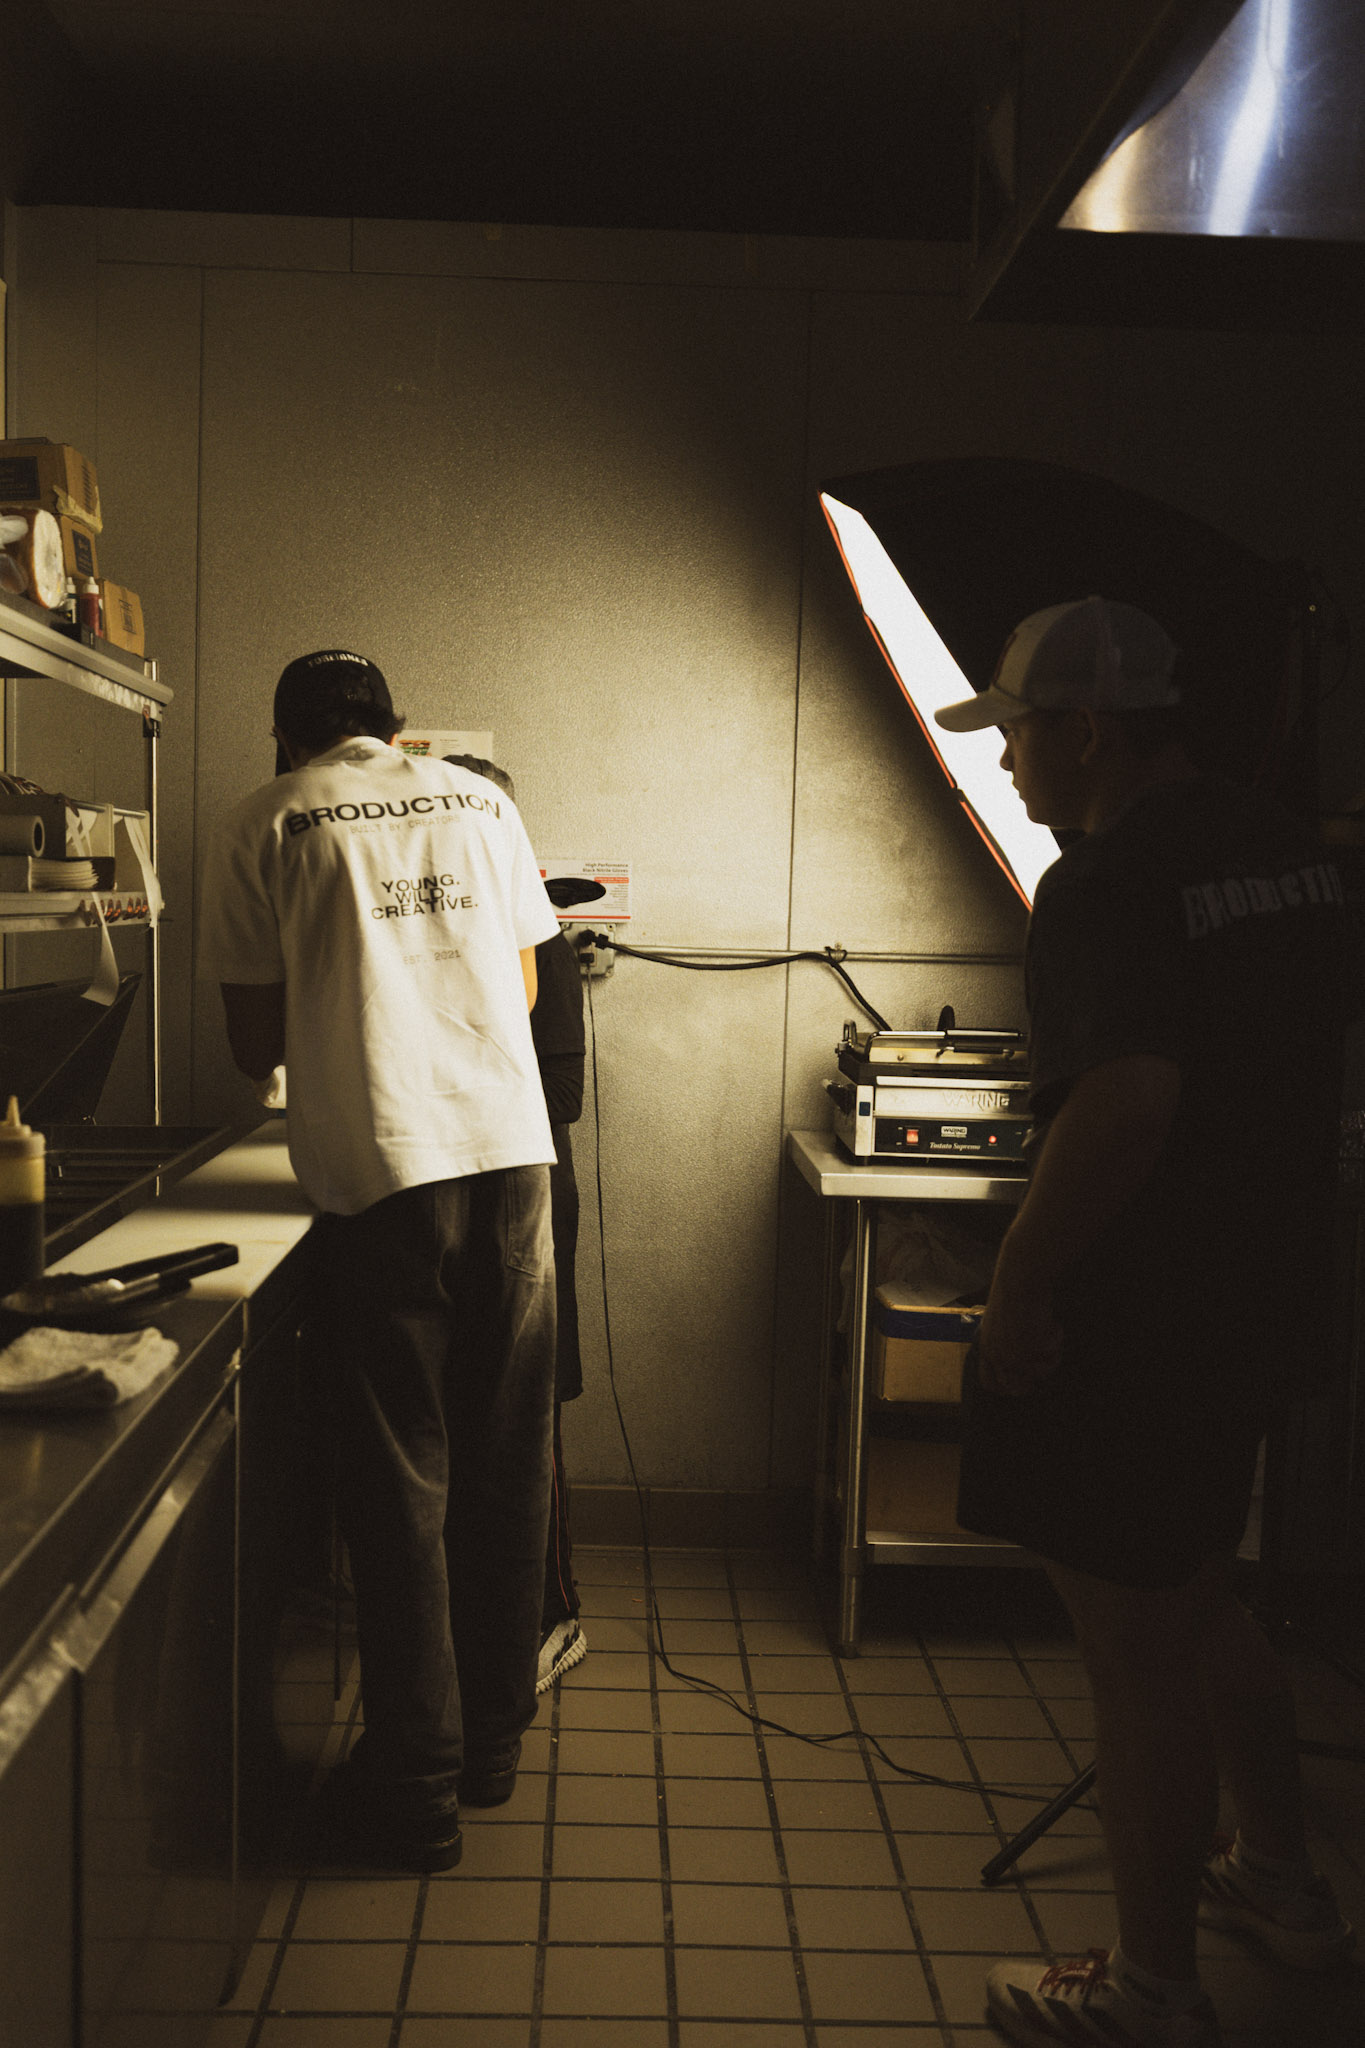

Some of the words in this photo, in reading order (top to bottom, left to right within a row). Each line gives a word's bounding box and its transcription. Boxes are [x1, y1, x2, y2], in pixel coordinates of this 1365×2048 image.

[285, 793, 500, 837] BRODUCTION
[349, 822, 382, 834] BUILT
[388, 821, 401, 833] BY
[407, 814, 461, 830] CREATORS
[381, 873, 460, 893] YOUNG.
[395, 887, 451, 904] WILD.
[371, 896, 479, 920] CREATIVE.
[434, 949, 461, 961] 2021
[942, 1090, 1010, 1112] WARING
[943, 1127, 966, 1136] WARING
[953, 1142, 981, 1152] Supremo
